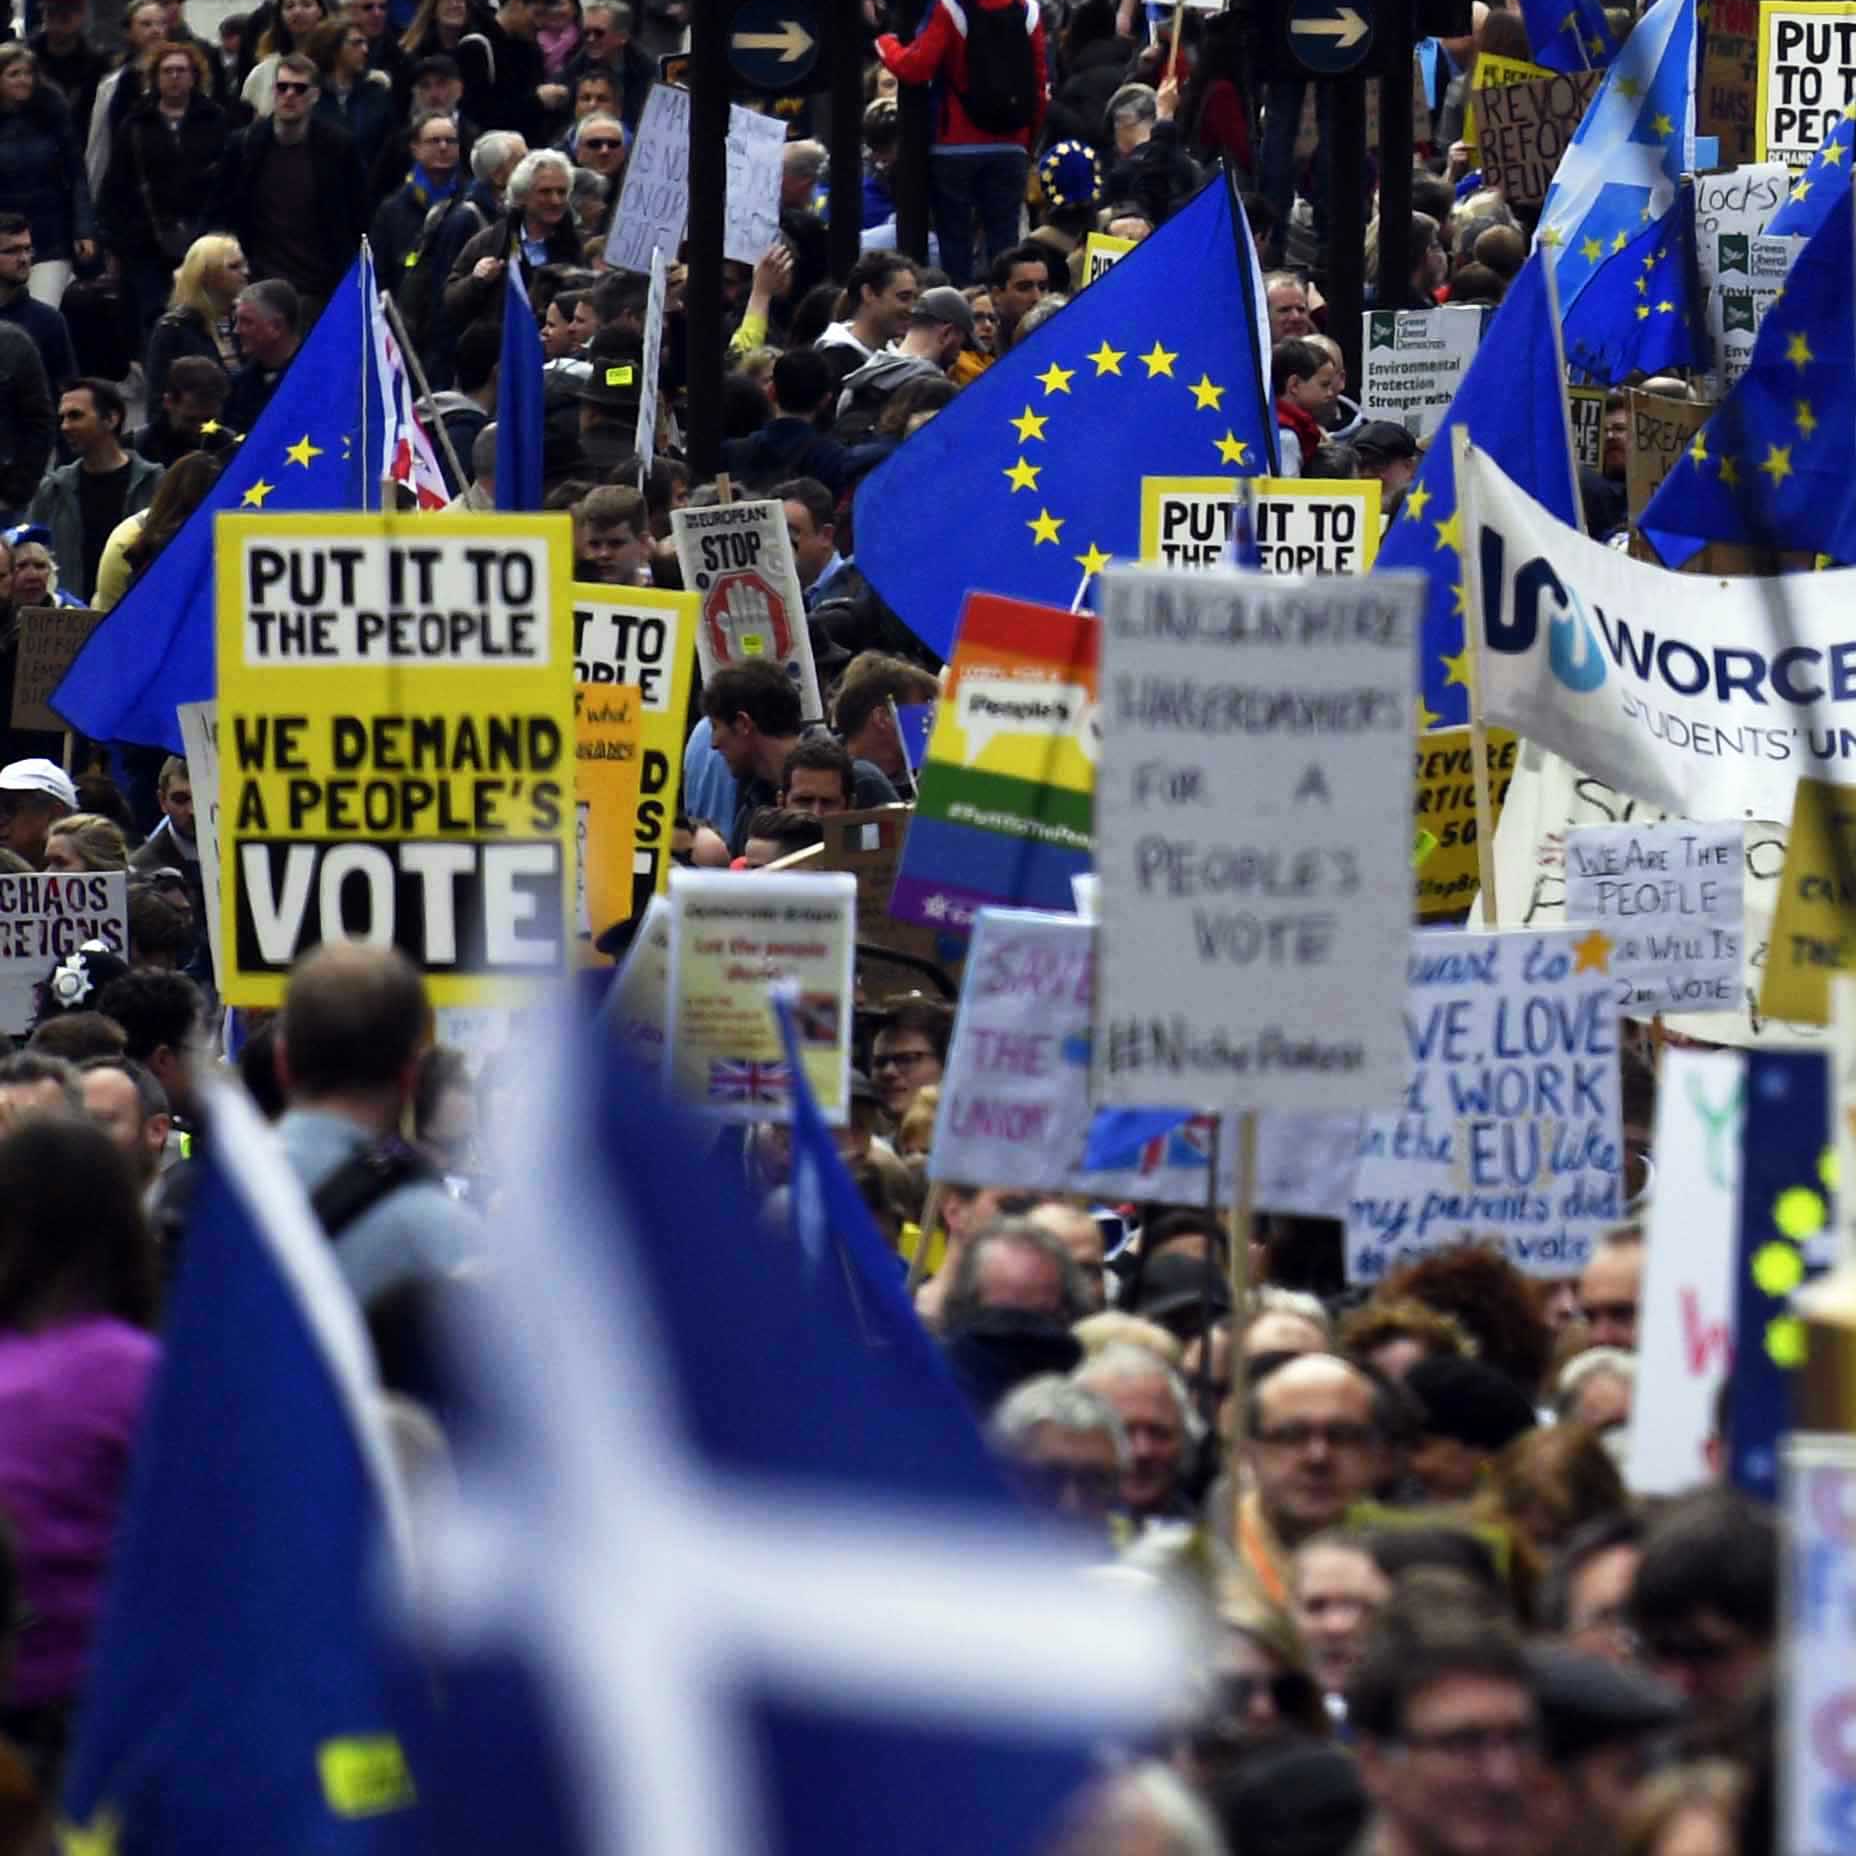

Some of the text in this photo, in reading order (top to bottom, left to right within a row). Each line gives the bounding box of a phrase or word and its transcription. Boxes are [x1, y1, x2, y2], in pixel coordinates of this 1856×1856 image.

[701, 534, 760, 568] STOP
[248, 549, 534, 605] PUT IT TO
[248, 612, 536, 656] THE PEOPLE
[968, 693, 1070, 722] People's
[1622, 692, 1800, 761] STUDENTS'
[236, 717, 305, 771] WE
[321, 717, 561, 771] DEMAND
[238, 777, 561, 832] A PEOPLE'S
[1573, 847, 1621, 877] WE
[0, 875, 108, 913] CHAOS
[241, 844, 561, 964] VOTE
[1191, 916, 1336, 965] VOTE
[1522, 941, 1569, 985] to
[1660, 971, 1733, 1002] VOTE
[1493, 999, 1617, 1057] LOVE
[1444, 1066, 1608, 1117] WORK
[1391, 1116, 1621, 1187] the EU like
[1348, 1191, 1621, 1257] my parents did
[1514, 1230, 1590, 1267] vote
